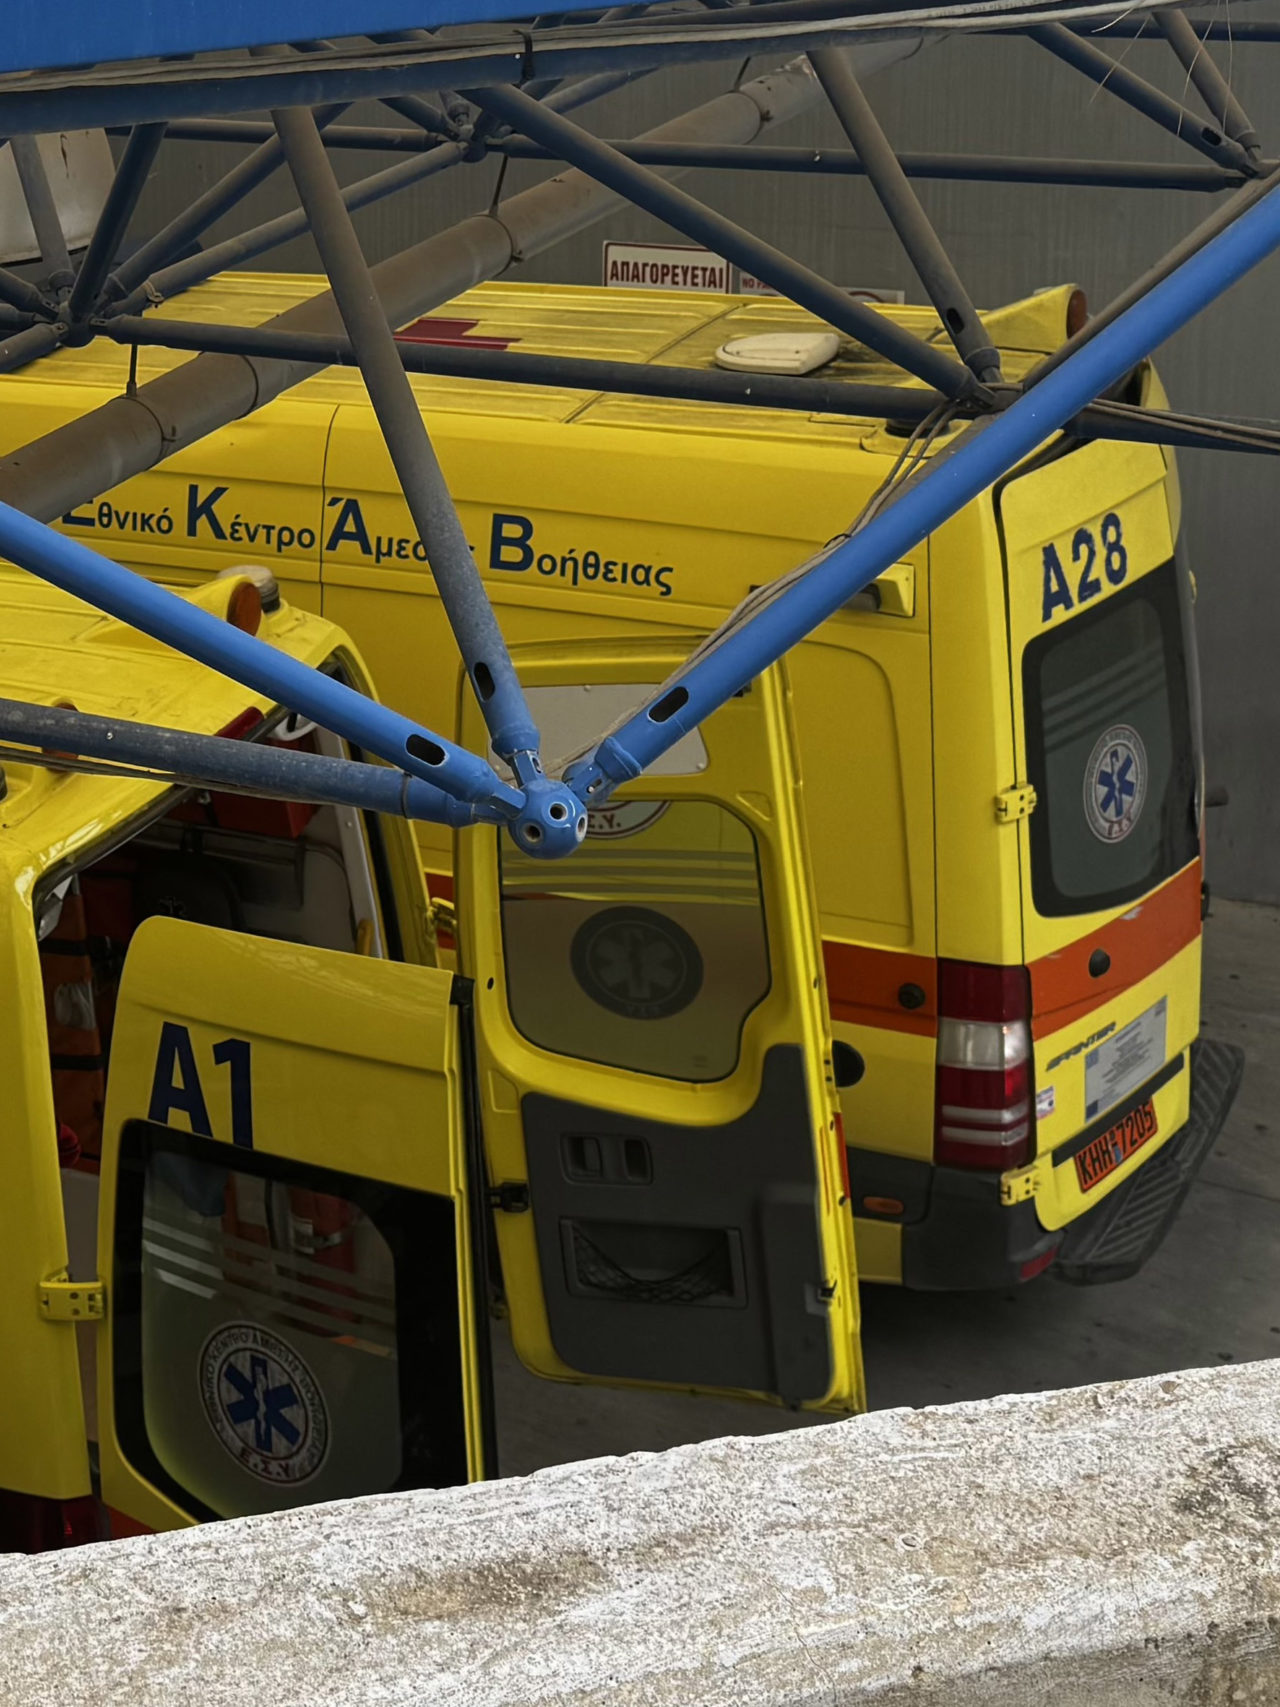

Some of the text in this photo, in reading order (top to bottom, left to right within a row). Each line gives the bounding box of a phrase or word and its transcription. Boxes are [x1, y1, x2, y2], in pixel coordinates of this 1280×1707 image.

[609, 259, 724, 289] ΑΠΑΓΟΡΕΥΕΤΑΙ
[185, 484, 316, 553] Κέντρο
[489, 511, 674, 597] Βοήθειας
[1041, 512, 1128, 623] A28
[147, 1020, 254, 1151] A1
